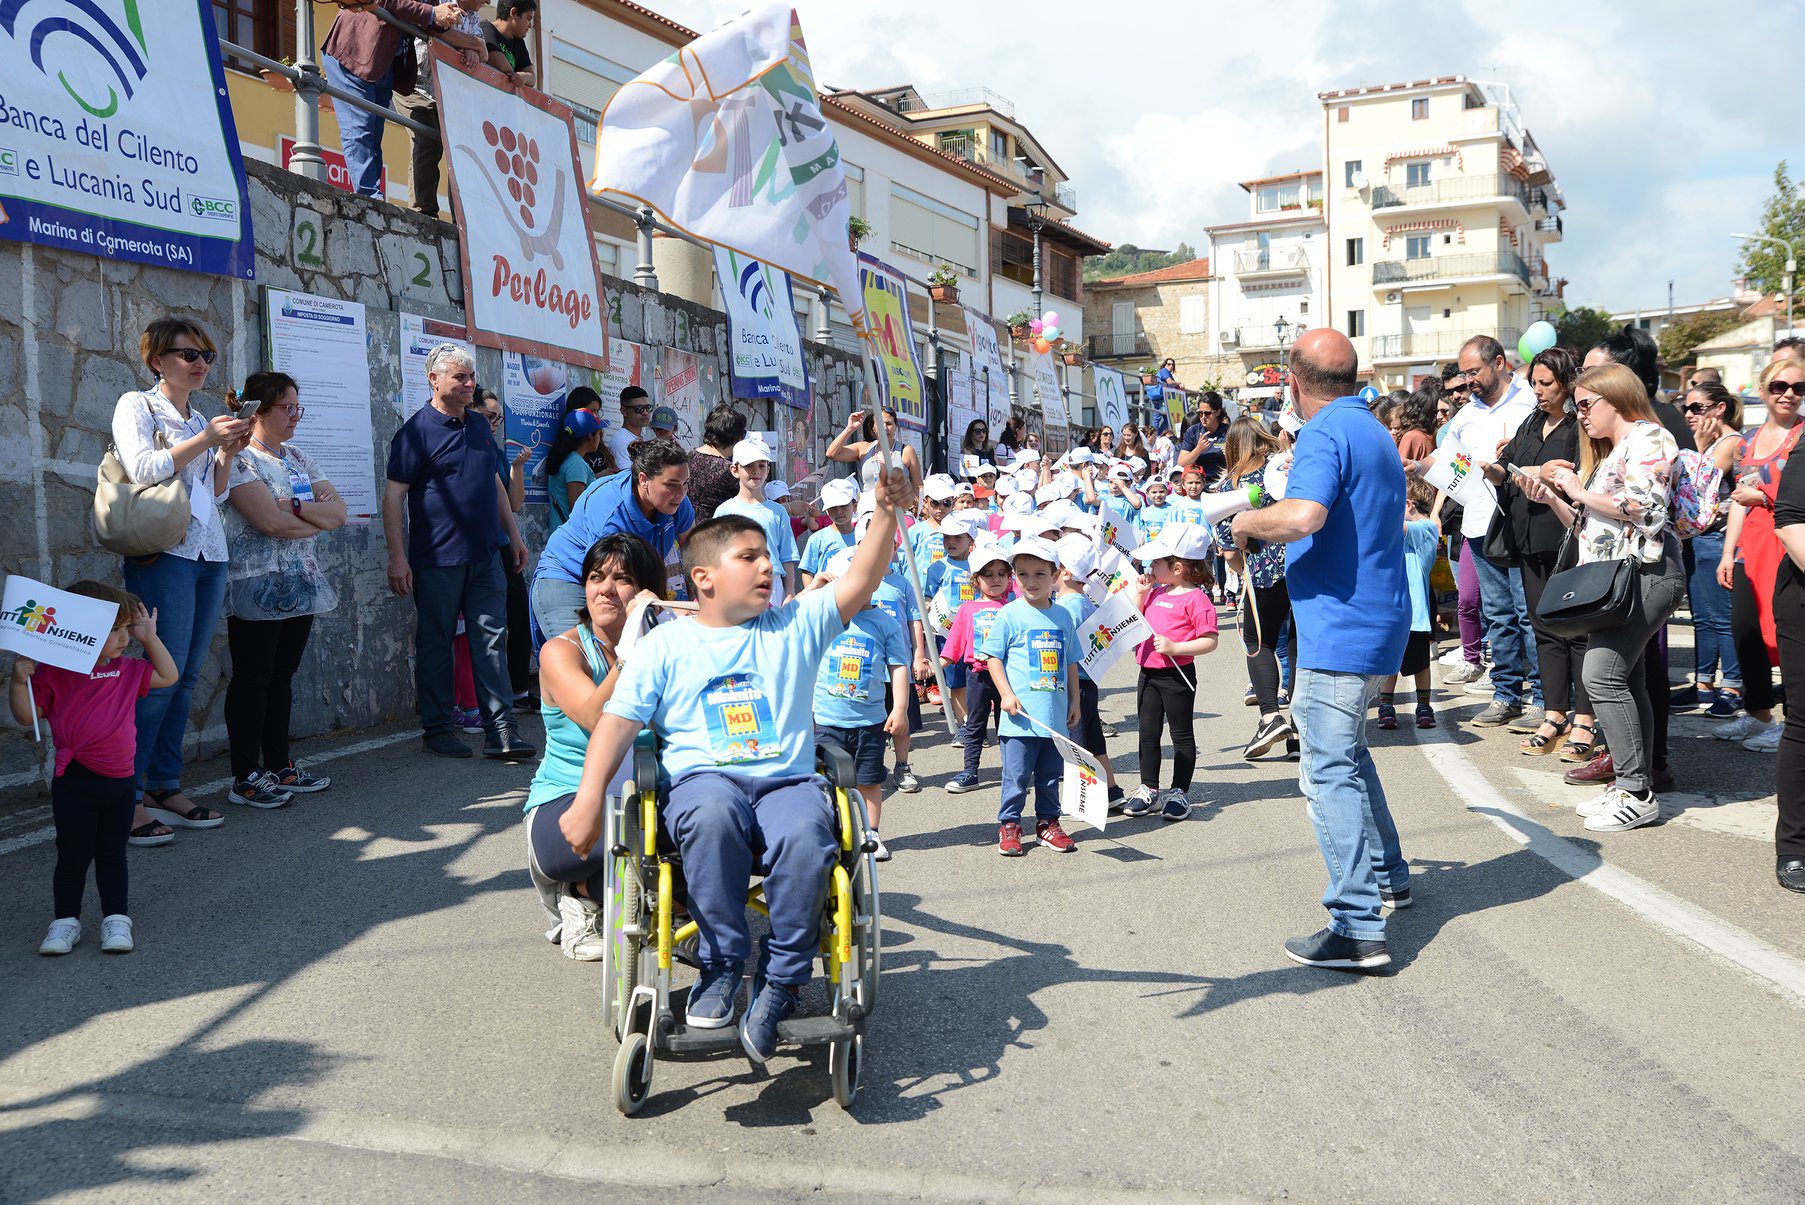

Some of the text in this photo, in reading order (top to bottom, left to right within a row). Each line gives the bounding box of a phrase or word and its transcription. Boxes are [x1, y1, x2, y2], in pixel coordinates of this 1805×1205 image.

[76, 118, 108, 152] del
[118, 129, 199, 174] Cilento
[26, 158, 40, 180] e
[48, 154, 136, 203] Lucania
[142, 179, 182, 214] Sud
[205, 200, 233, 214] BCC
[29, 216, 78, 241] Marina
[81, 229, 94, 244] di
[166, 243, 193, 264] (SA)
[297, 220, 323, 267] 2
[412, 252, 432, 288] 2
[292, 297, 313, 307] COMUNE
[319, 301, 345, 311] CAMEROTA
[492, 254, 592, 329] Perlage
[742, 328, 770, 345] Banca
[47, 626, 97, 647] NSIEME
[1083, 614, 1139, 667] TUTT NSIEME
[841, 663, 859, 672] MD
[1042, 656, 1057, 665] MD
[728, 712, 753, 726] MD
[1078, 779, 1087, 814] NSIEME
